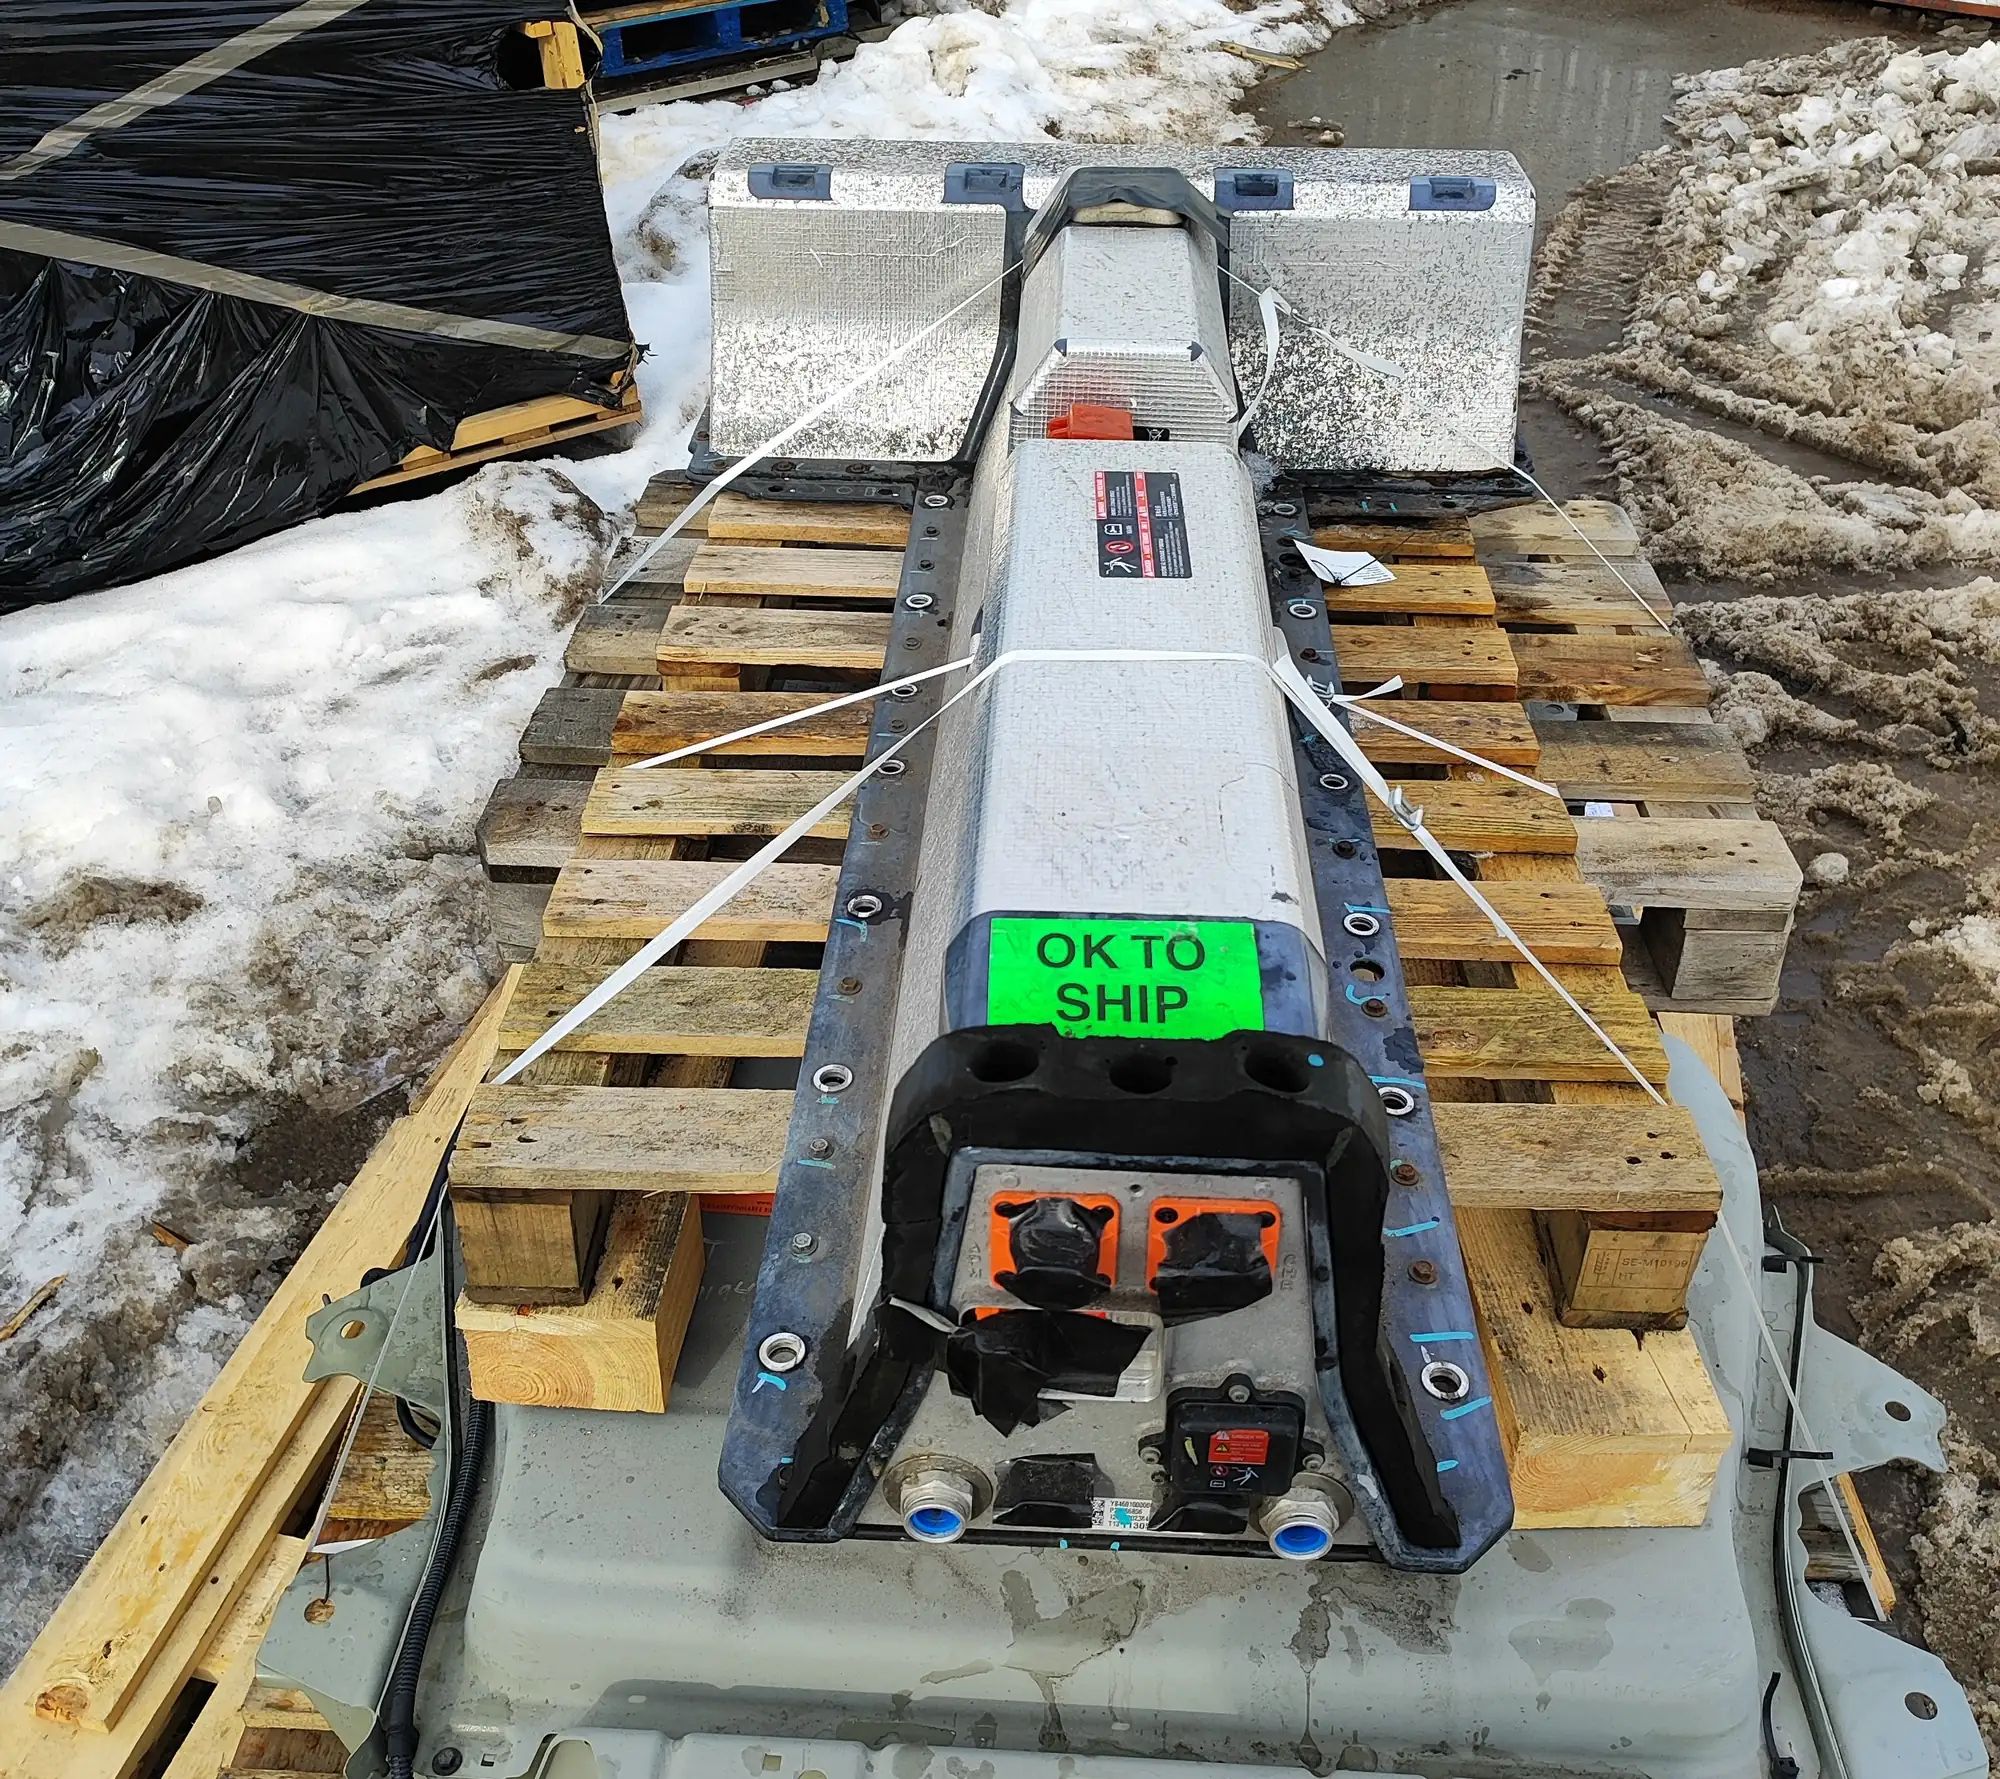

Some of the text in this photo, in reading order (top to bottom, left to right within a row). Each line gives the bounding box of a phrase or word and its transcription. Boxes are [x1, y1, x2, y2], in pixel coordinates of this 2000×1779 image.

[1037, 932, 1206, 971] OK TO
[1056, 982, 1188, 1024] SHIP
